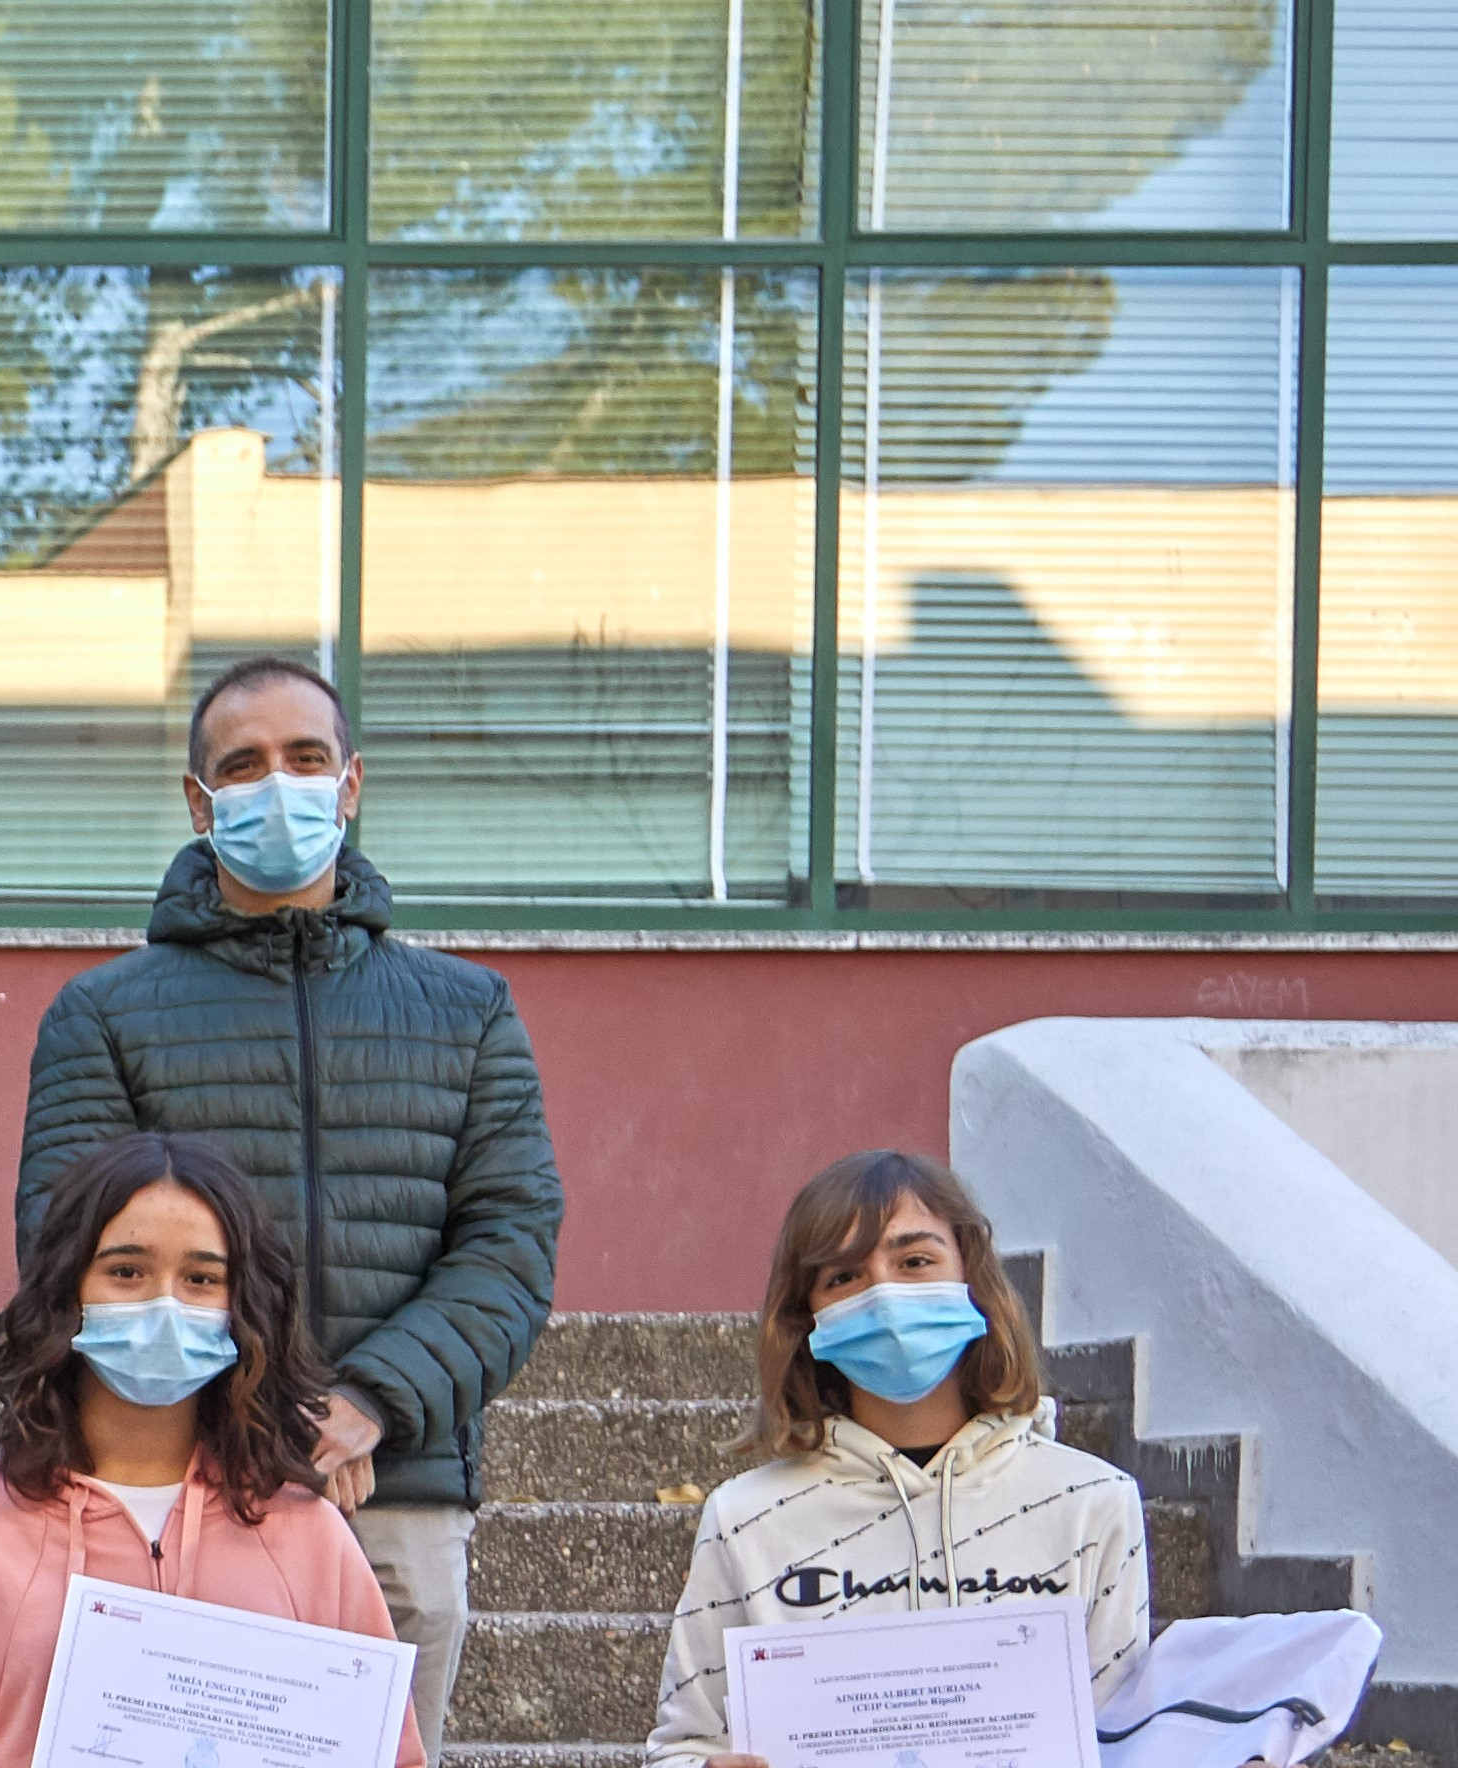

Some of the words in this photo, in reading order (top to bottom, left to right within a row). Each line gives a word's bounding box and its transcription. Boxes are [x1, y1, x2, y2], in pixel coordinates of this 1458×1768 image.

[775, 1567, 1069, 1607] Champion
[834, 1691, 880, 1703] AINHOA
[882, 1687, 924, 1699] ALBERT
[926, 1682, 981, 1695] MURIANA
